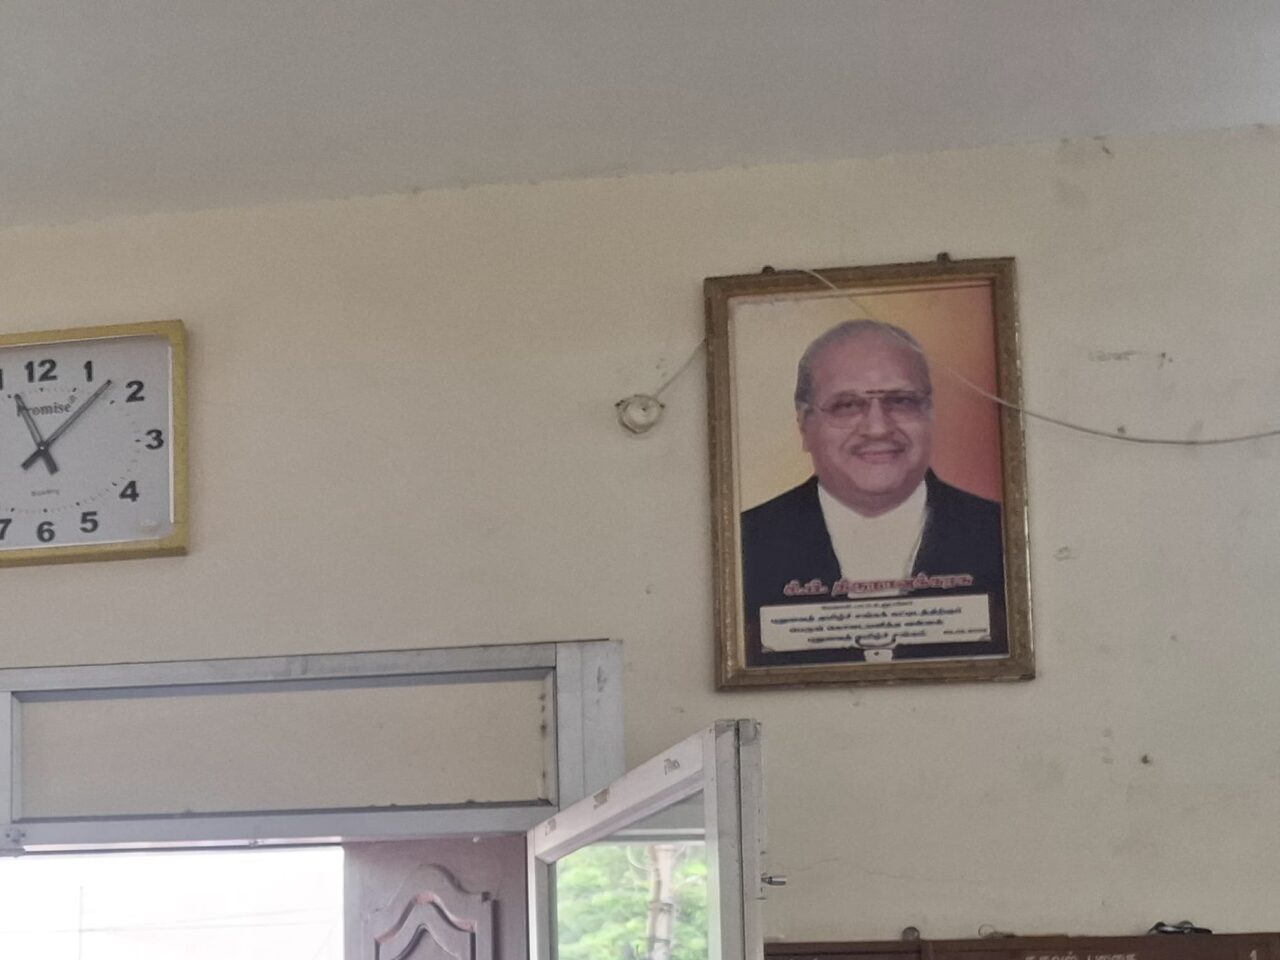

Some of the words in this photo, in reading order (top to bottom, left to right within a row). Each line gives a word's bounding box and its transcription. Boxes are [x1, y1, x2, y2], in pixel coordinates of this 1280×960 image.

[24, 359, 57, 383] 12
[83, 360, 94, 382] 1
[125, 380, 145, 403] 2
[145, 429, 164, 450] 3
[119, 480, 139, 502] 4
[36, 521, 55, 542] 6
[79, 511, 99, 533] 5
